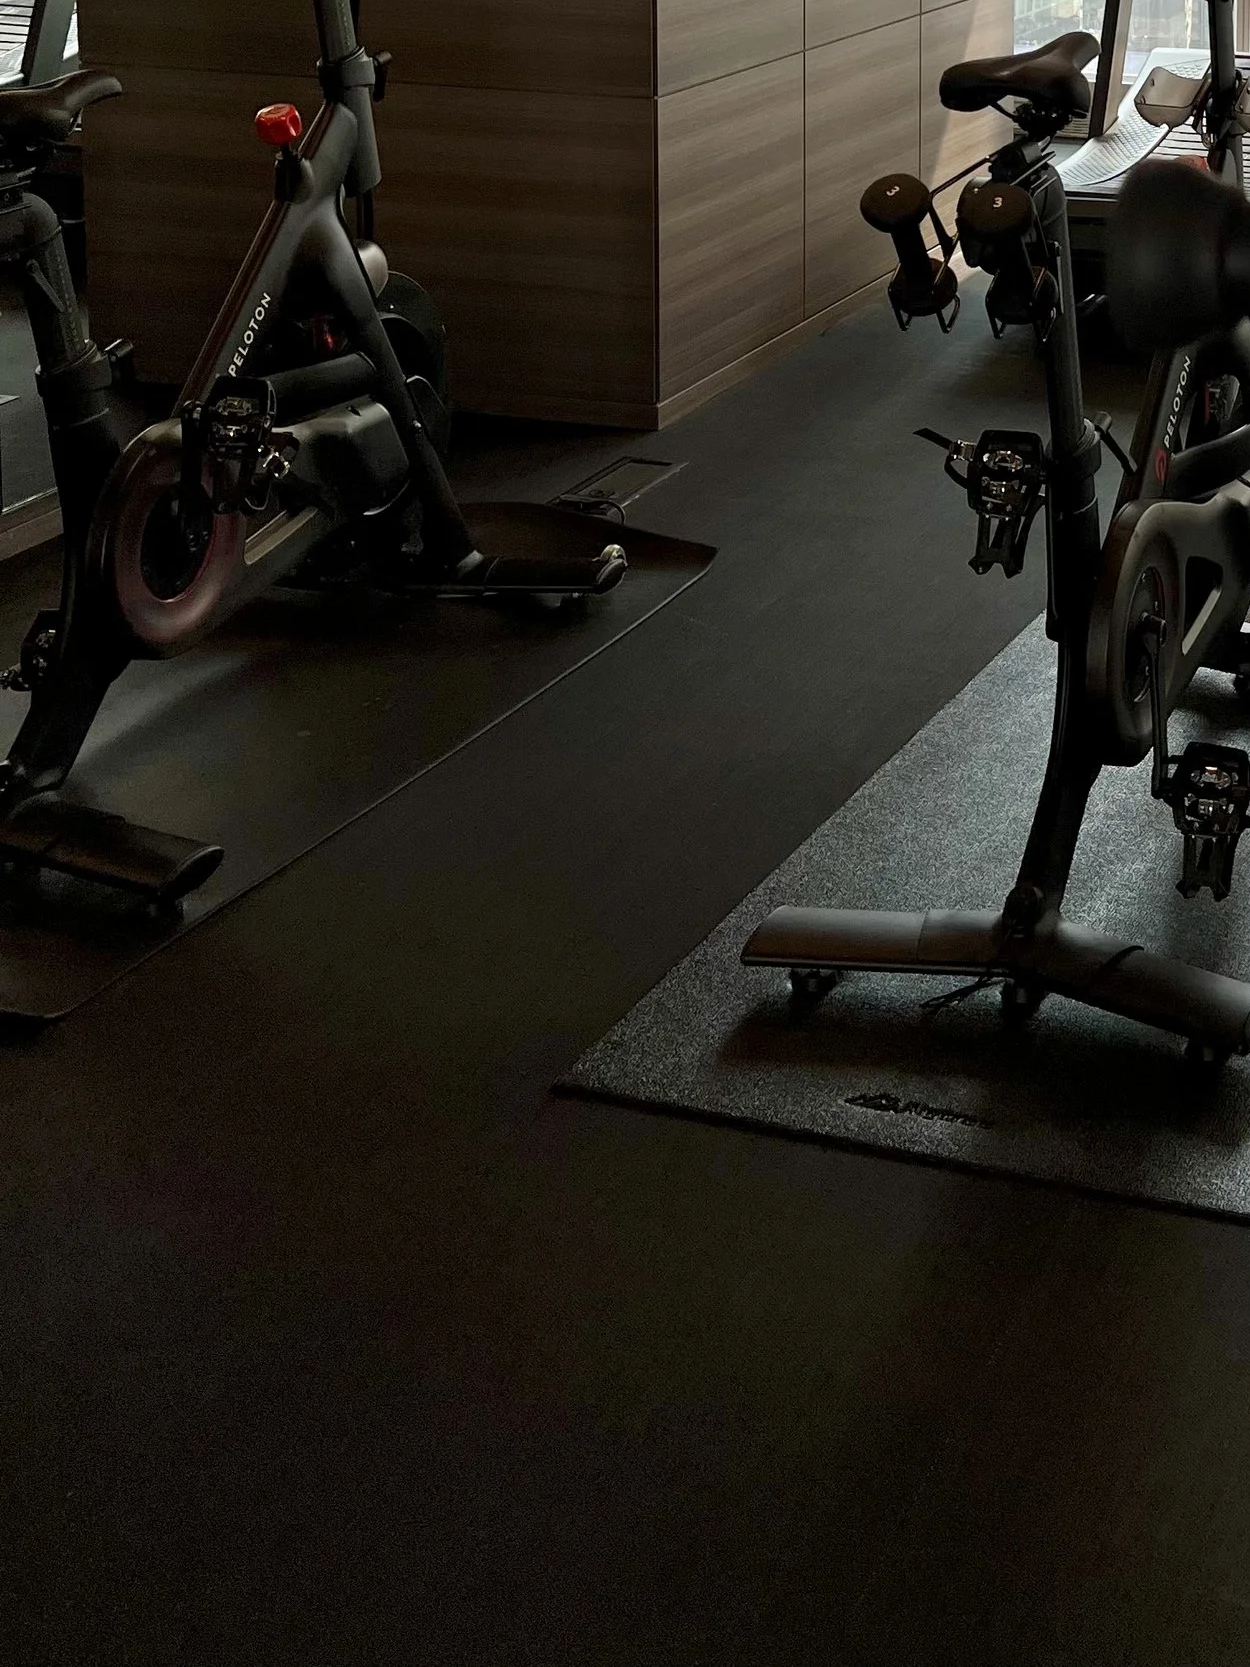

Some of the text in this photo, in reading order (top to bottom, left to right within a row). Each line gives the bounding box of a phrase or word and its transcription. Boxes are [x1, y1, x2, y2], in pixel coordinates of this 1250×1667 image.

[886, 185, 900, 196] 3
[993, 197, 1003, 208] 3
[228, 292, 271, 377] PELOTON
[1164, 356, 1191, 448] PELOTON
